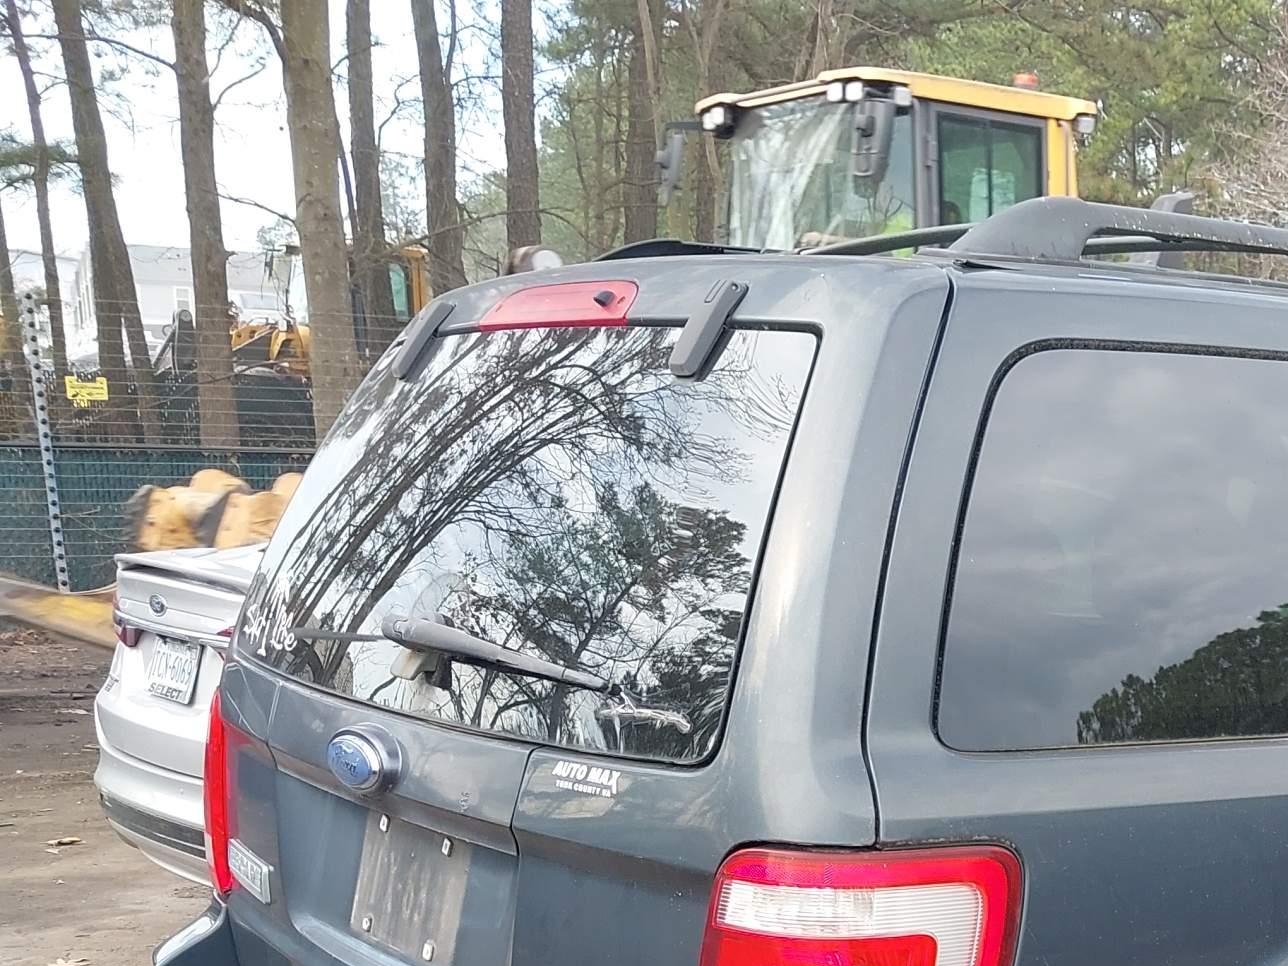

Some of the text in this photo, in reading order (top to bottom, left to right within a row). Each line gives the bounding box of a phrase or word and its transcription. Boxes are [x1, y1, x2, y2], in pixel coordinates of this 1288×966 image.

[148, 682, 183, 700] SELECT
[551, 760, 622, 795] AUTO MAX
[573, 782, 601, 795] COUNTY
